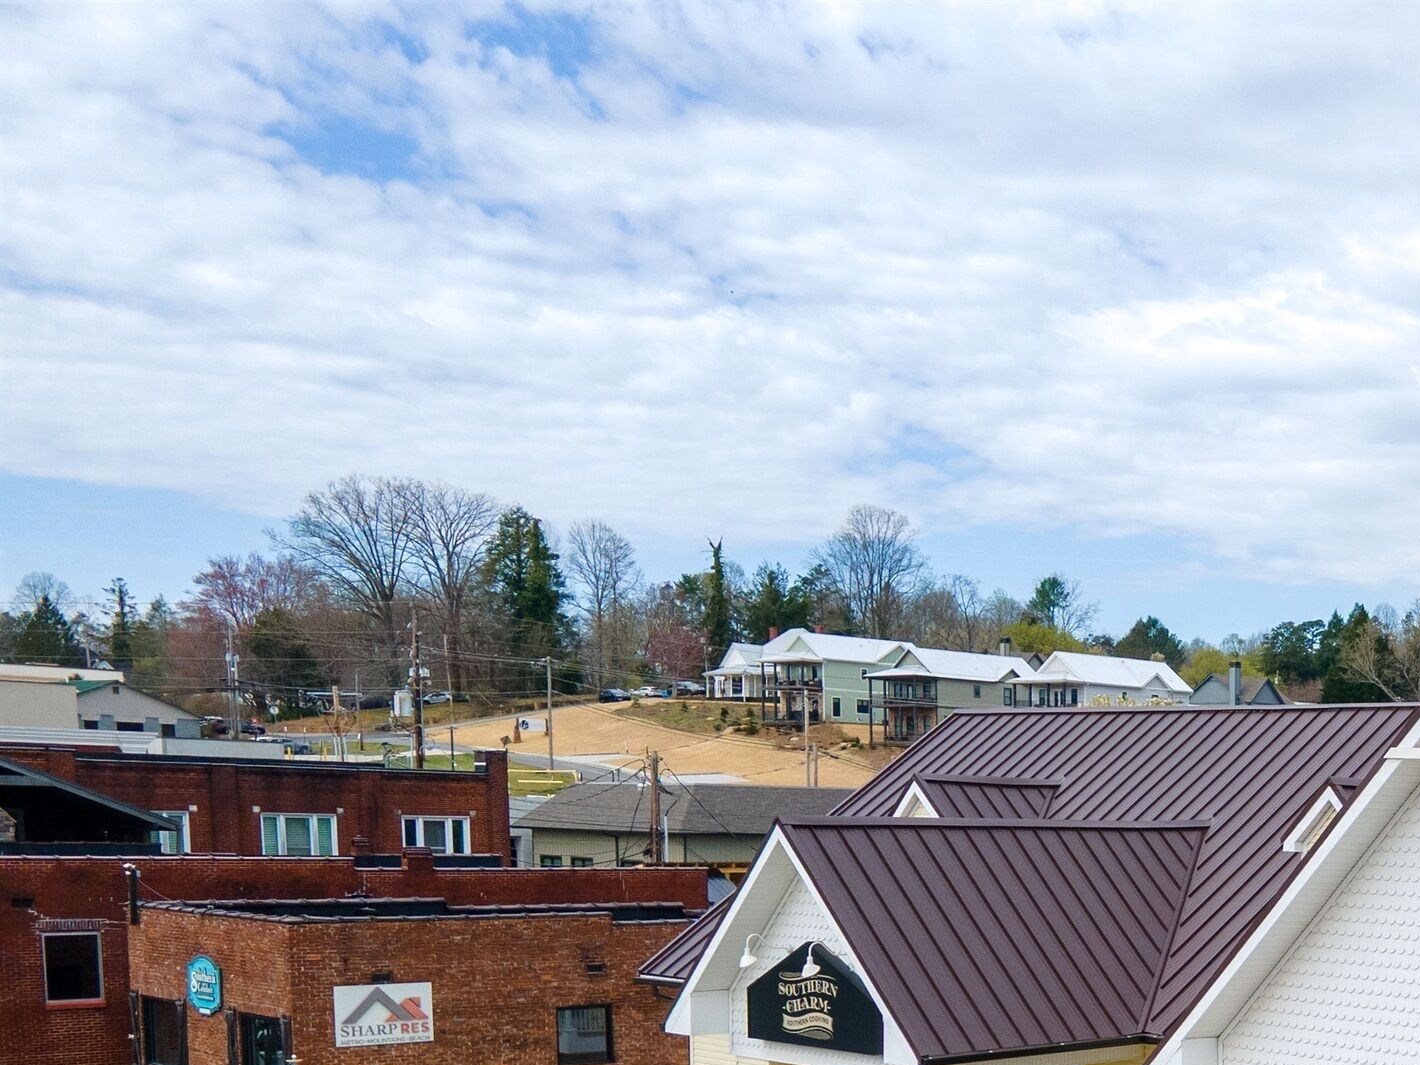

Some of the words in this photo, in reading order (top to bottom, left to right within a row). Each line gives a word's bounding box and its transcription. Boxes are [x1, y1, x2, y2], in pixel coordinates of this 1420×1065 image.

[778, 980, 838, 998] SOUTHERN
[340, 1024, 398, 1038] SHARP
[400, 1022, 430, 1034] RES
